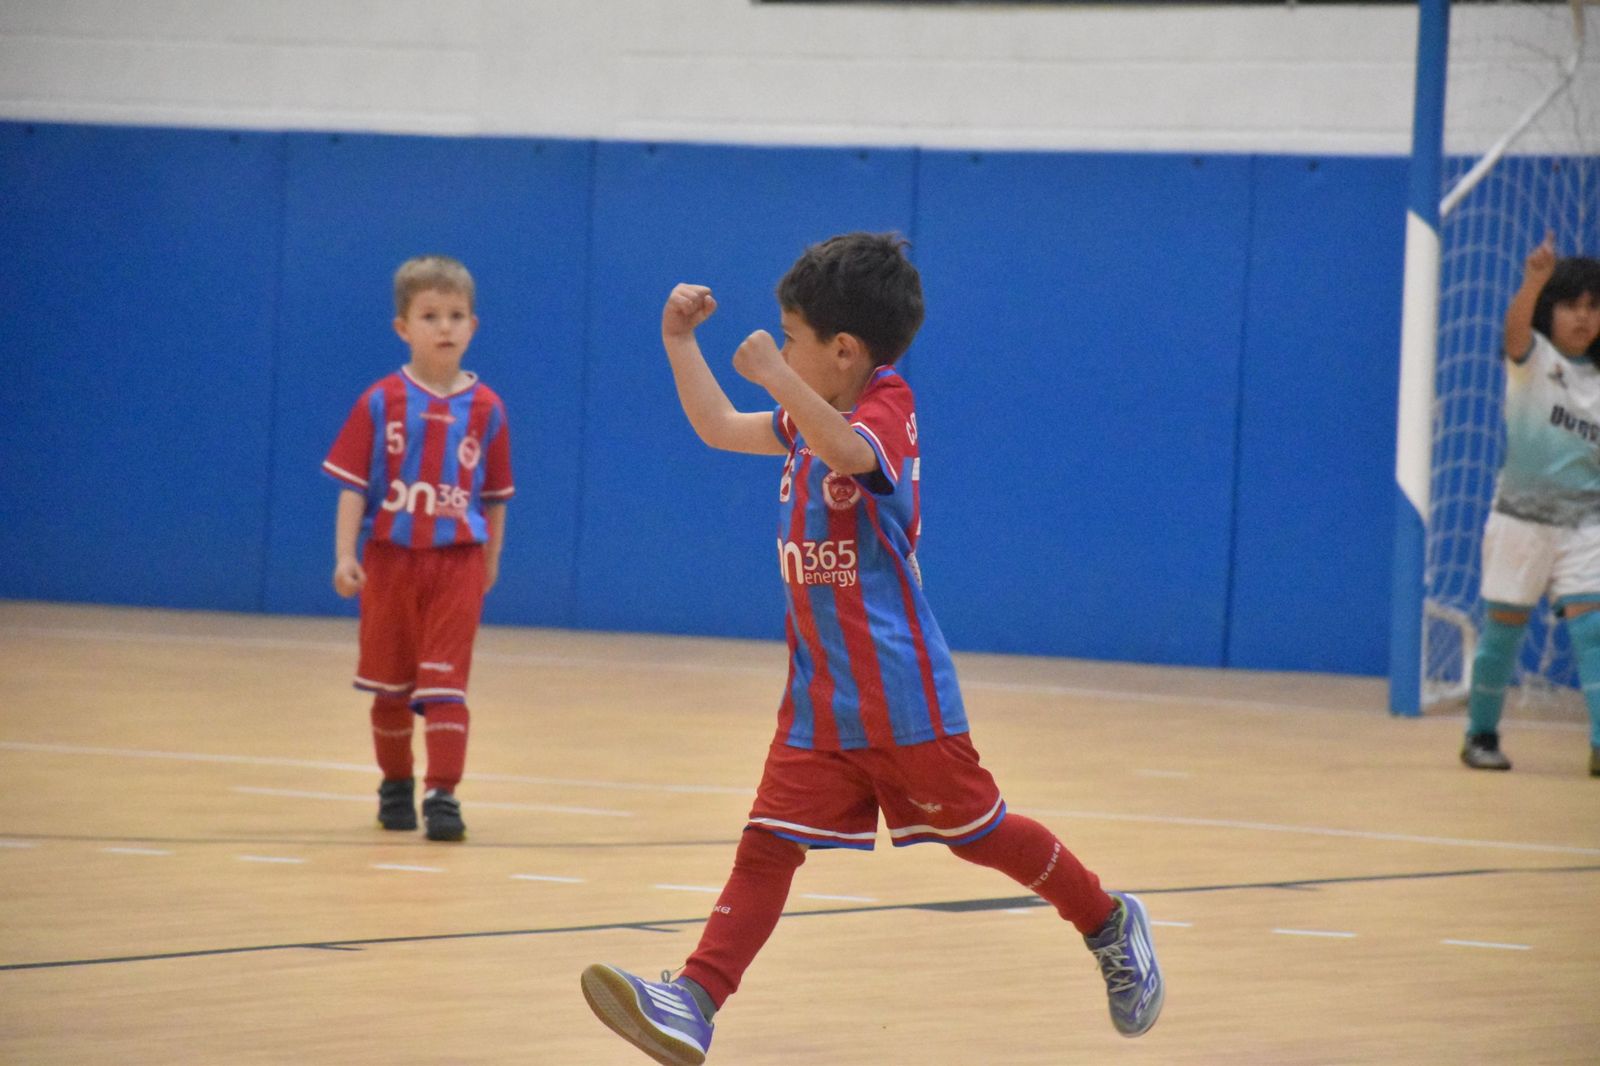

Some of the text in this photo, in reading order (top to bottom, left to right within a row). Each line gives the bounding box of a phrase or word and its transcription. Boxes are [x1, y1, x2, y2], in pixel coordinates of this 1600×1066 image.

[386, 421, 404, 454] 5
[777, 538, 856, 584] n 365
[804, 570, 856, 587] energy
